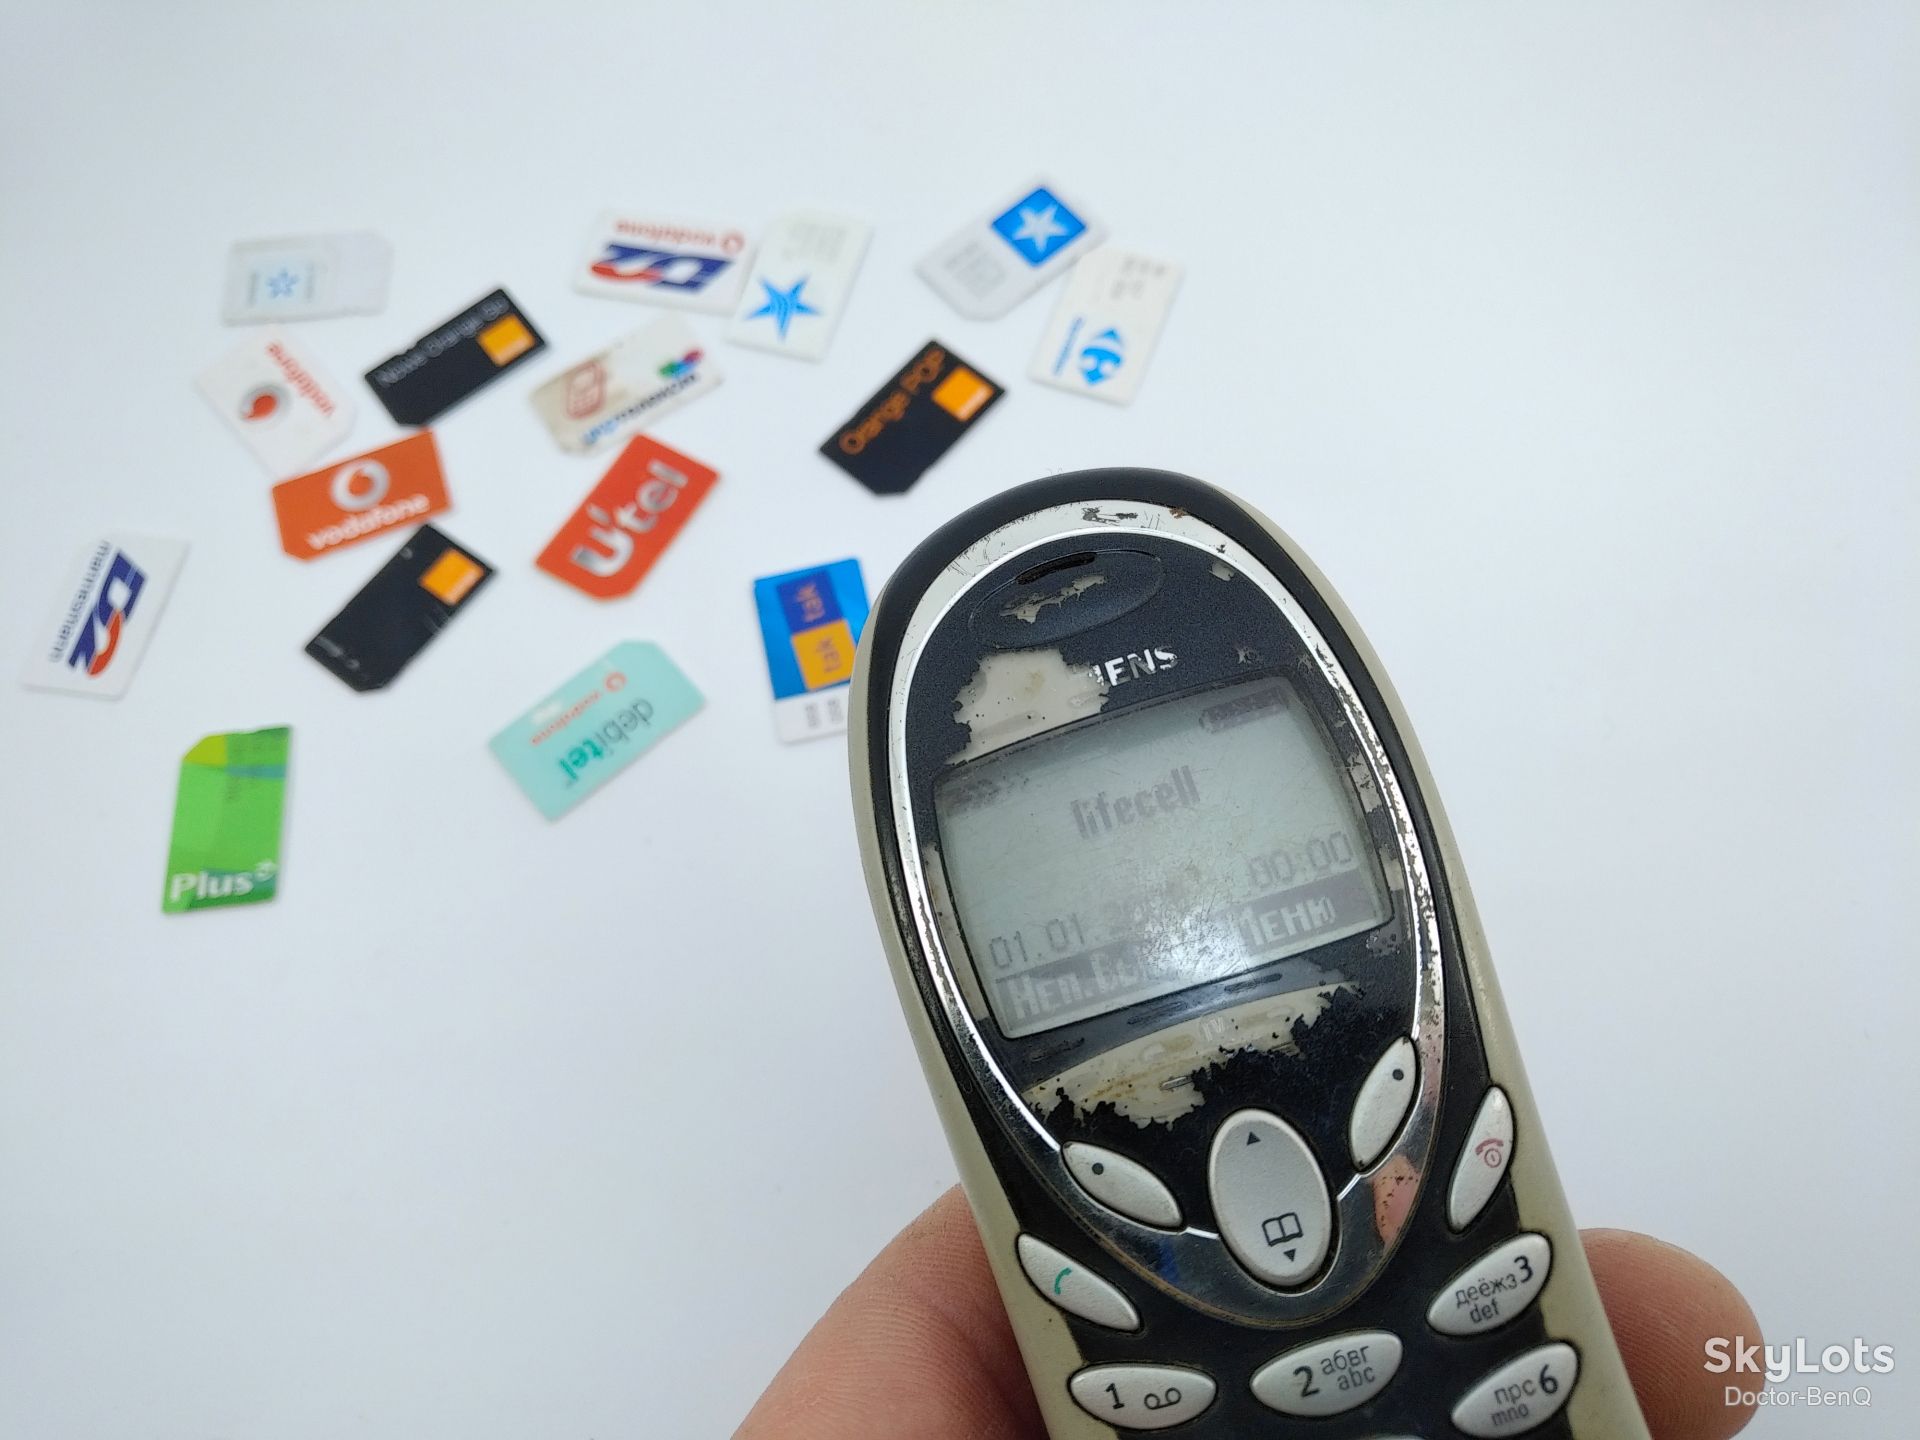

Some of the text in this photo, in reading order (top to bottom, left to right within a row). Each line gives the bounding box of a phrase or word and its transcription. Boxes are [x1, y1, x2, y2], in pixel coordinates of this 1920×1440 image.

[307, 493, 430, 550] vodafone
[558, 697, 655, 782] debitel
[170, 870, 254, 903] Plus
[1514, 1255, 1534, 1283] 3
[1469, 1299, 1500, 1324] def
[1293, 1345, 1369, 1398] 2 абвг
[1337, 1366, 1376, 1391] abc
[1494, 1364, 1558, 1405] прс 6
[1106, 1383, 1125, 1409] 1
[1491, 1403, 1529, 1426] mno
